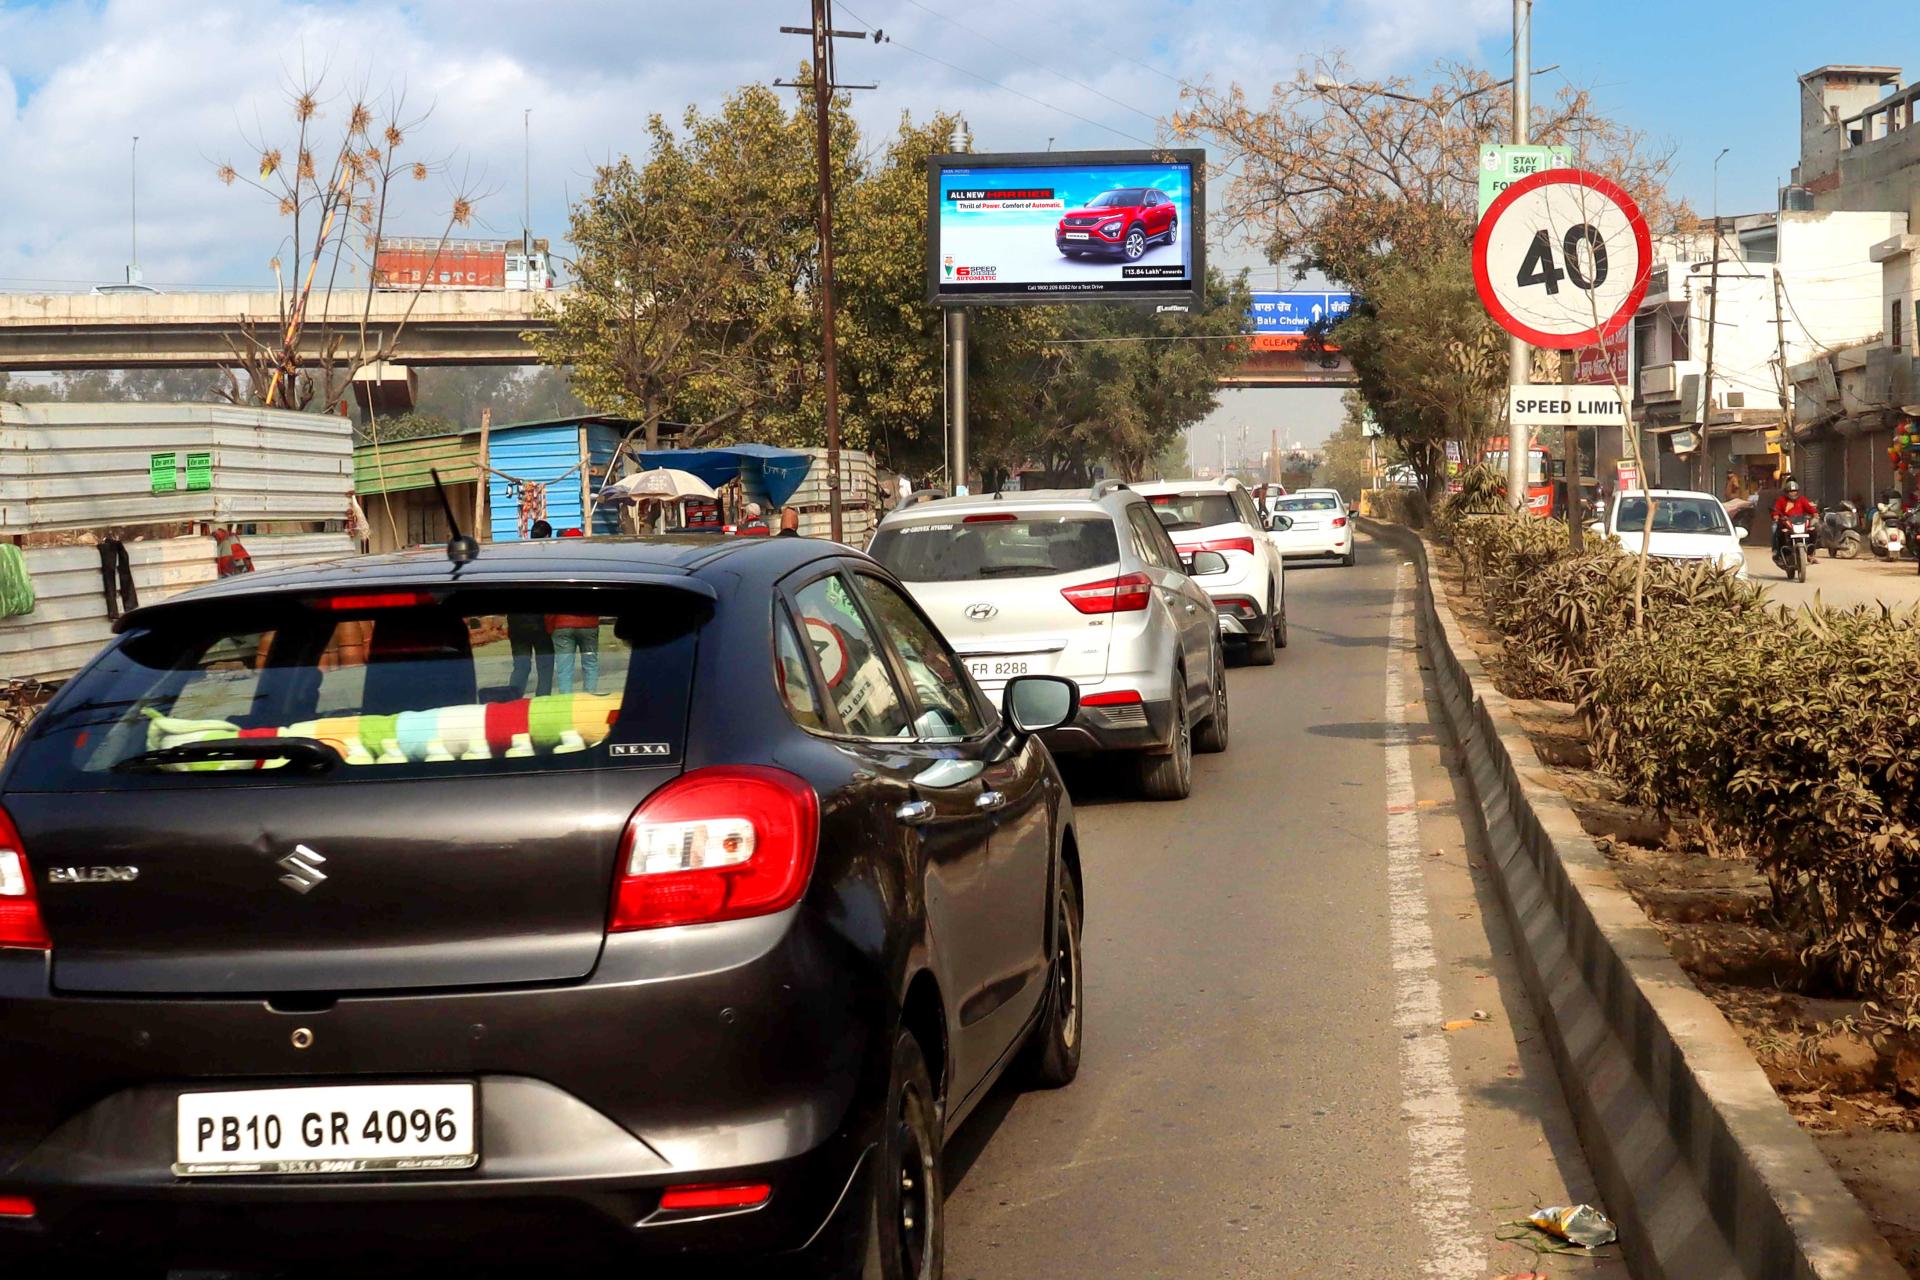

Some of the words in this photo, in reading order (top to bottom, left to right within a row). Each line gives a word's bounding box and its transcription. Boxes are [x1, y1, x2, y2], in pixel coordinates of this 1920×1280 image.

[1513, 156, 1537, 165] STAY
[1512, 165, 1537, 174] SAFE
[950, 191, 966, 199] ALL
[966, 191, 985, 199] NEW
[986, 190, 1051, 198] HARRIER
[1516, 223, 1609, 296] 40
[956, 266, 970, 276] 6
[1256, 316, 1277, 325] Bala
[1280, 316, 1309, 325] Chowk
[1515, 399, 1572, 414] SPEED
[1577, 400, 1623, 415] LIMIT
[994, 662, 1028, 675] 8288
[613, 744, 667, 754] NEXA
[47, 866, 140, 883] BALENO
[197, 1113, 282, 1153] PB10
[301, 1111, 350, 1149] GR
[361, 1107, 458, 1145] 4096
